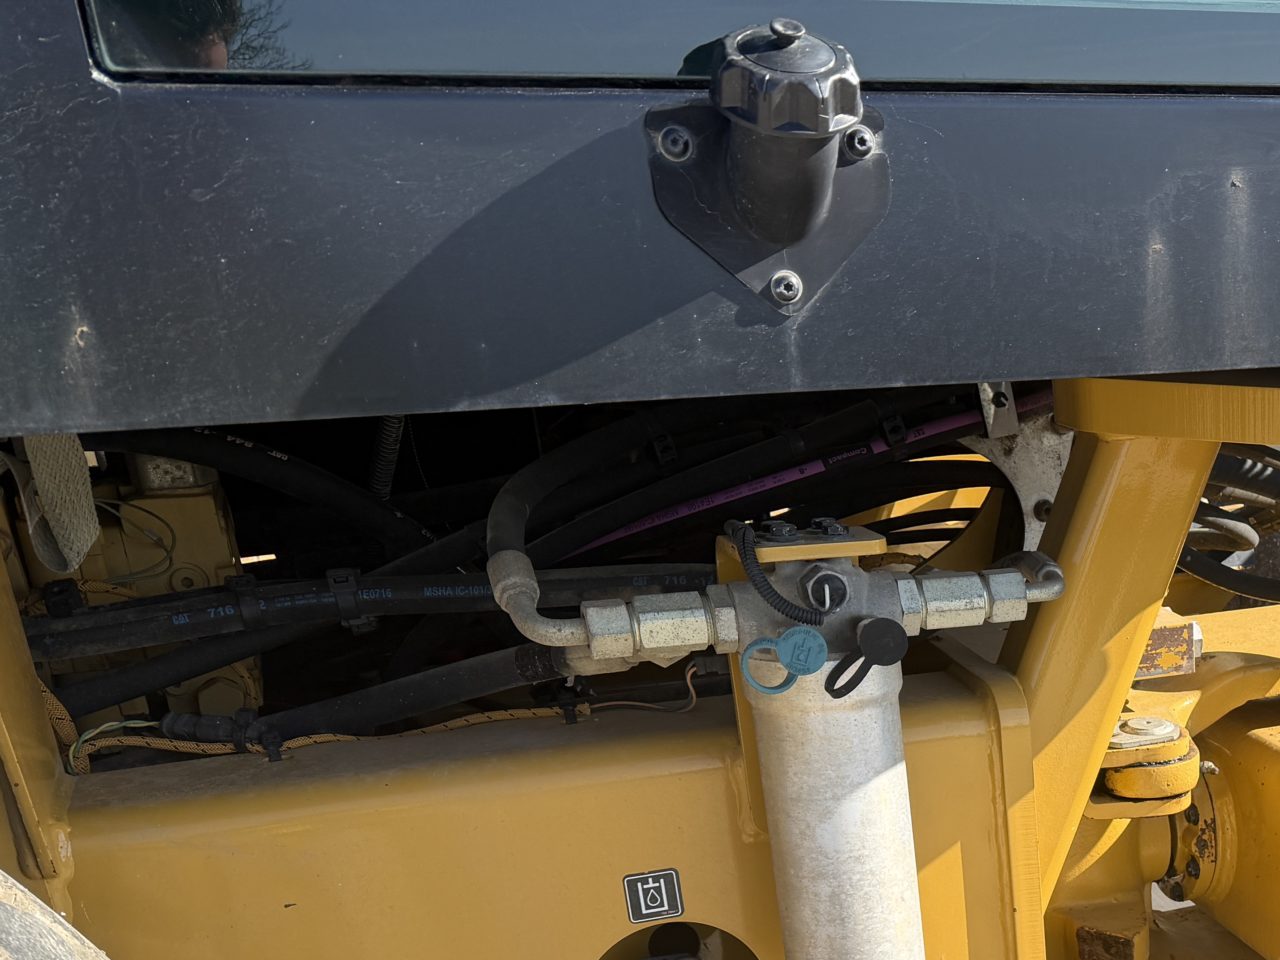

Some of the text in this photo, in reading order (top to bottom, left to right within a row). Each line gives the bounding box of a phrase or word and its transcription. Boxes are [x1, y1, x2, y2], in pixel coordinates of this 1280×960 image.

[663, 575, 687, 585] 716
[206, 604, 235, 619] 716
[423, 584, 453, 598] MSHA
